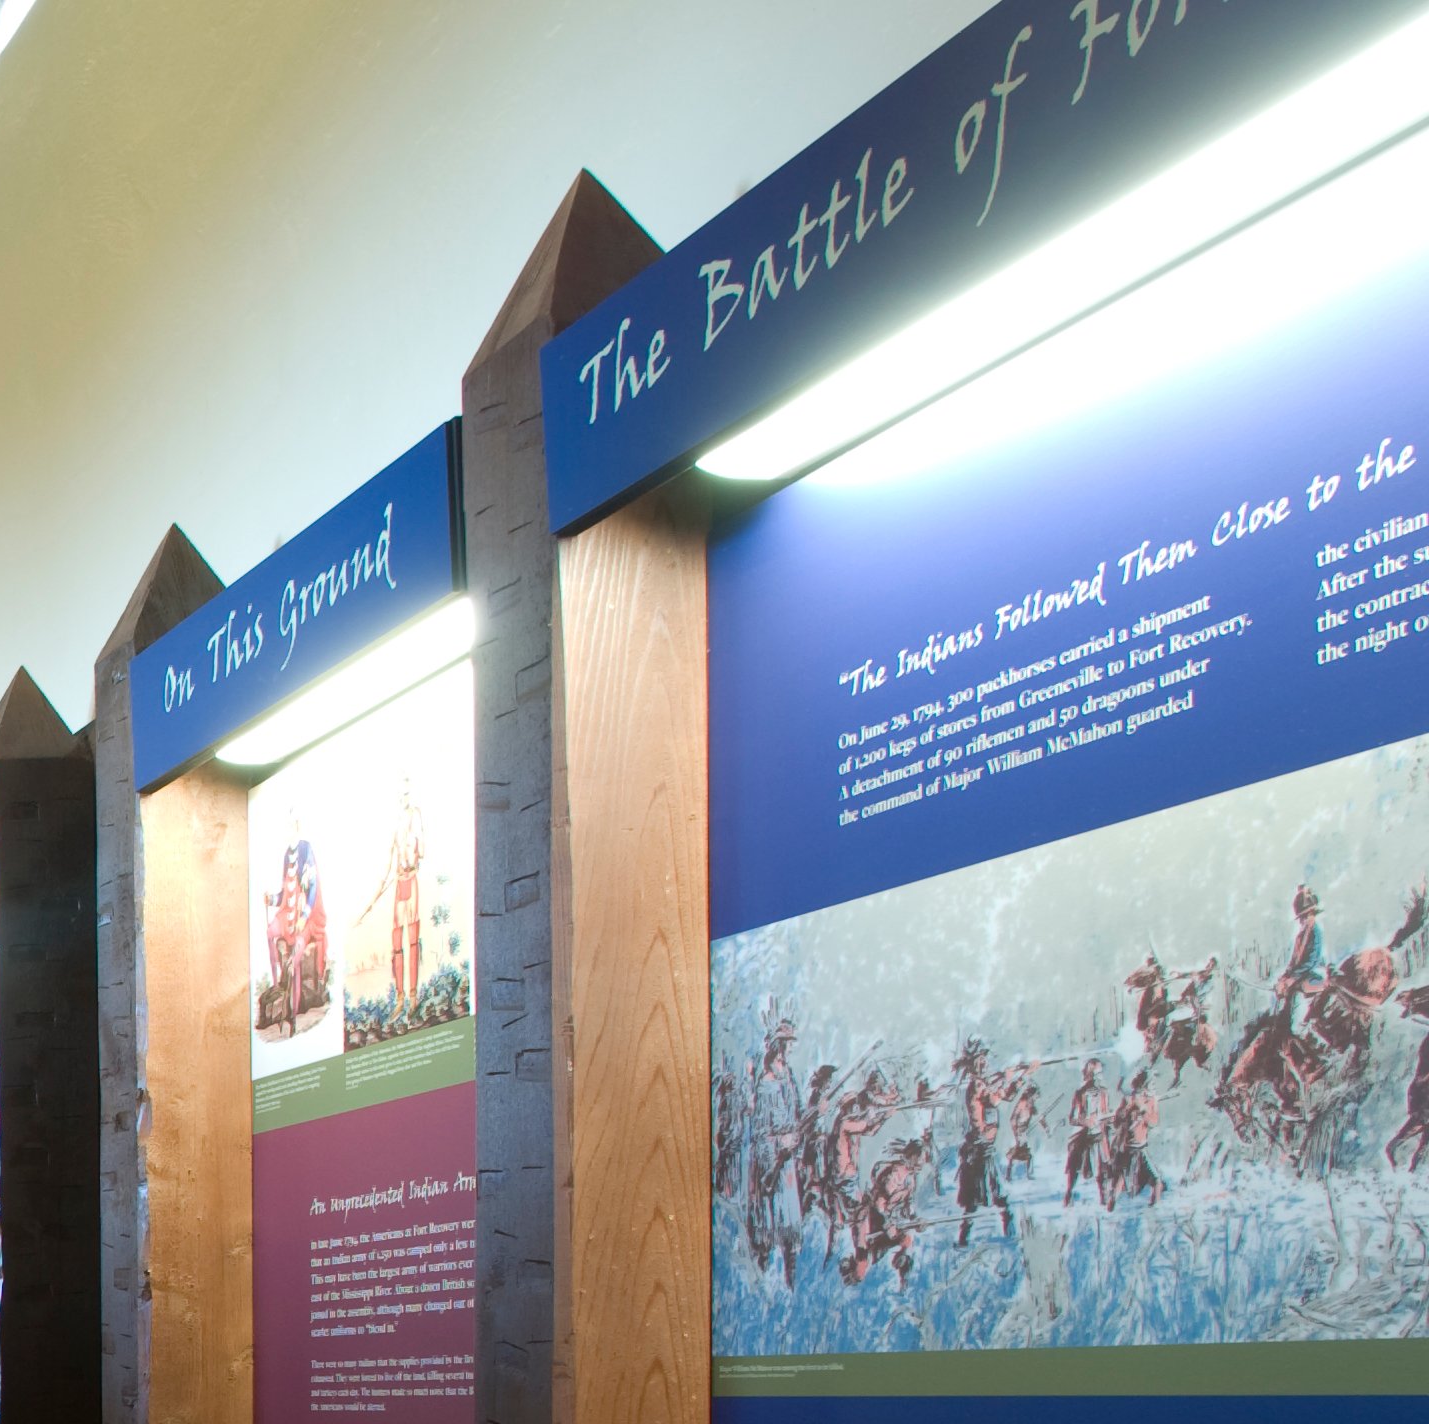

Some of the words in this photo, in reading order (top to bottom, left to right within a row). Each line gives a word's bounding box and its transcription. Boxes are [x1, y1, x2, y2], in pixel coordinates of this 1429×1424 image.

[579, 317, 671, 425] The
[697, 147, 915, 352] Battle
[954, 24, 1033, 227] of
[164, 664, 197, 713] On
[206, 602, 264, 684] This
[279, 501, 397, 671] Ground
[895, 624, 984, 679] Indians
[994, 562, 1108, 641] Followed
[1116, 539, 1198, 587] Them
[1210, 495, 1293, 547] Close
[1305, 473, 1341, 512] to
[1355, 436, 1417, 492] the
[1315, 568, 1368, 602] After
[1374, 554, 1408, 579] the
[1316, 543, 1349, 567] the
[1316, 609, 1348, 633] the
[838, 733, 857, 749] On
[860, 721, 888, 745] June
[947, 687, 973, 713] 300
[976, 655, 1056, 703] packhorses
[1059, 629, 1114, 666] carried
[1118, 628, 1128, 643] a
[1131, 595, 1209, 638] shipment
[838, 755, 852, 775] of
[888, 736, 917, 757] kegs
[919, 724, 935, 745] of
[936, 714, 977, 739] stores
[980, 699, 1015, 723] from
[1018, 665, 1103, 708] Greeneville
[1107, 659, 1125, 677] to
[1129, 643, 1164, 669] Fort
[1169, 613, 1251, 655] Recovery.
[1317, 642, 1348, 665] the
[1354, 620, 1408, 653] night
[838, 785, 850, 802] A
[851, 759, 924, 796] detachment
[926, 748, 942, 769] of
[943, 746, 963, 767] 90
[965, 724, 1025, 756] riflemen
[1027, 708, 1056, 734] and
[1059, 705, 1078, 728] 50
[1081, 677, 1155, 715] dragoons
[1159, 657, 1209, 688] under
[839, 808, 859, 826] the
[861, 783, 923, 819] command
[925, 776, 940, 797] of
[943, 766, 982, 791] Major
[987, 746, 1043, 775] William
[1046, 719, 1123, 757] McMahon
[1126, 690, 1193, 735] guarded
[309, 1196, 327, 1216] An
[408, 1176, 449, 1206] Indian
